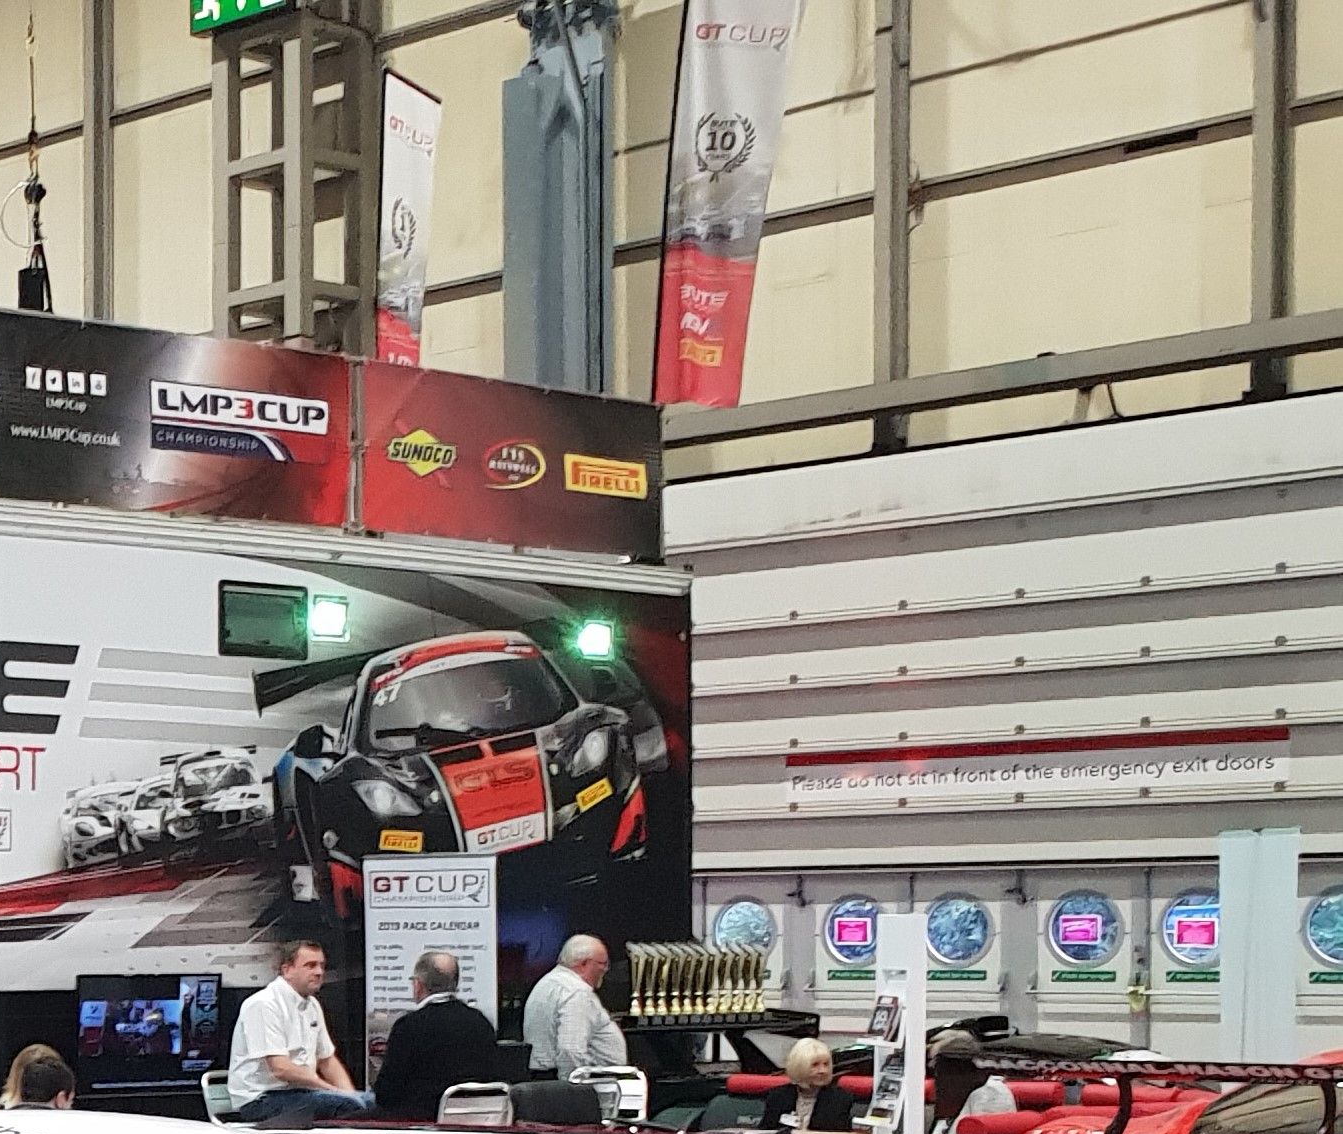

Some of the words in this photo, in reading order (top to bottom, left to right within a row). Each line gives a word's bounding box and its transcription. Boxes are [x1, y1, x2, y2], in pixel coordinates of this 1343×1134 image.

[730, 25, 786, 43] CUP
[705, 131, 737, 152] 10
[158, 387, 326, 427] LMP3CUP
[155, 429, 260, 452] CHAMPIONSHIP
[390, 440, 453, 465] SUNOCO
[572, 461, 641, 494] PIRELLI
[792, 774, 842, 791] Please
[874, 773, 904, 787] not
[908, 770, 927, 785] sit
[932, 770, 948, 784] in
[953, 767, 997, 783] front
[1000, 763, 1021, 781] of
[1025, 764, 1054, 780] the
[1061, 761, 1166, 780] emergency
[1172, 757, 1209, 773] exit
[1216, 753, 1275, 771] doors
[373, 875, 410, 893] GT
[415, 873, 479, 893] CUP
[402, 921, 428, 931] RACE
[429, 921, 481, 931] CALENDAR
